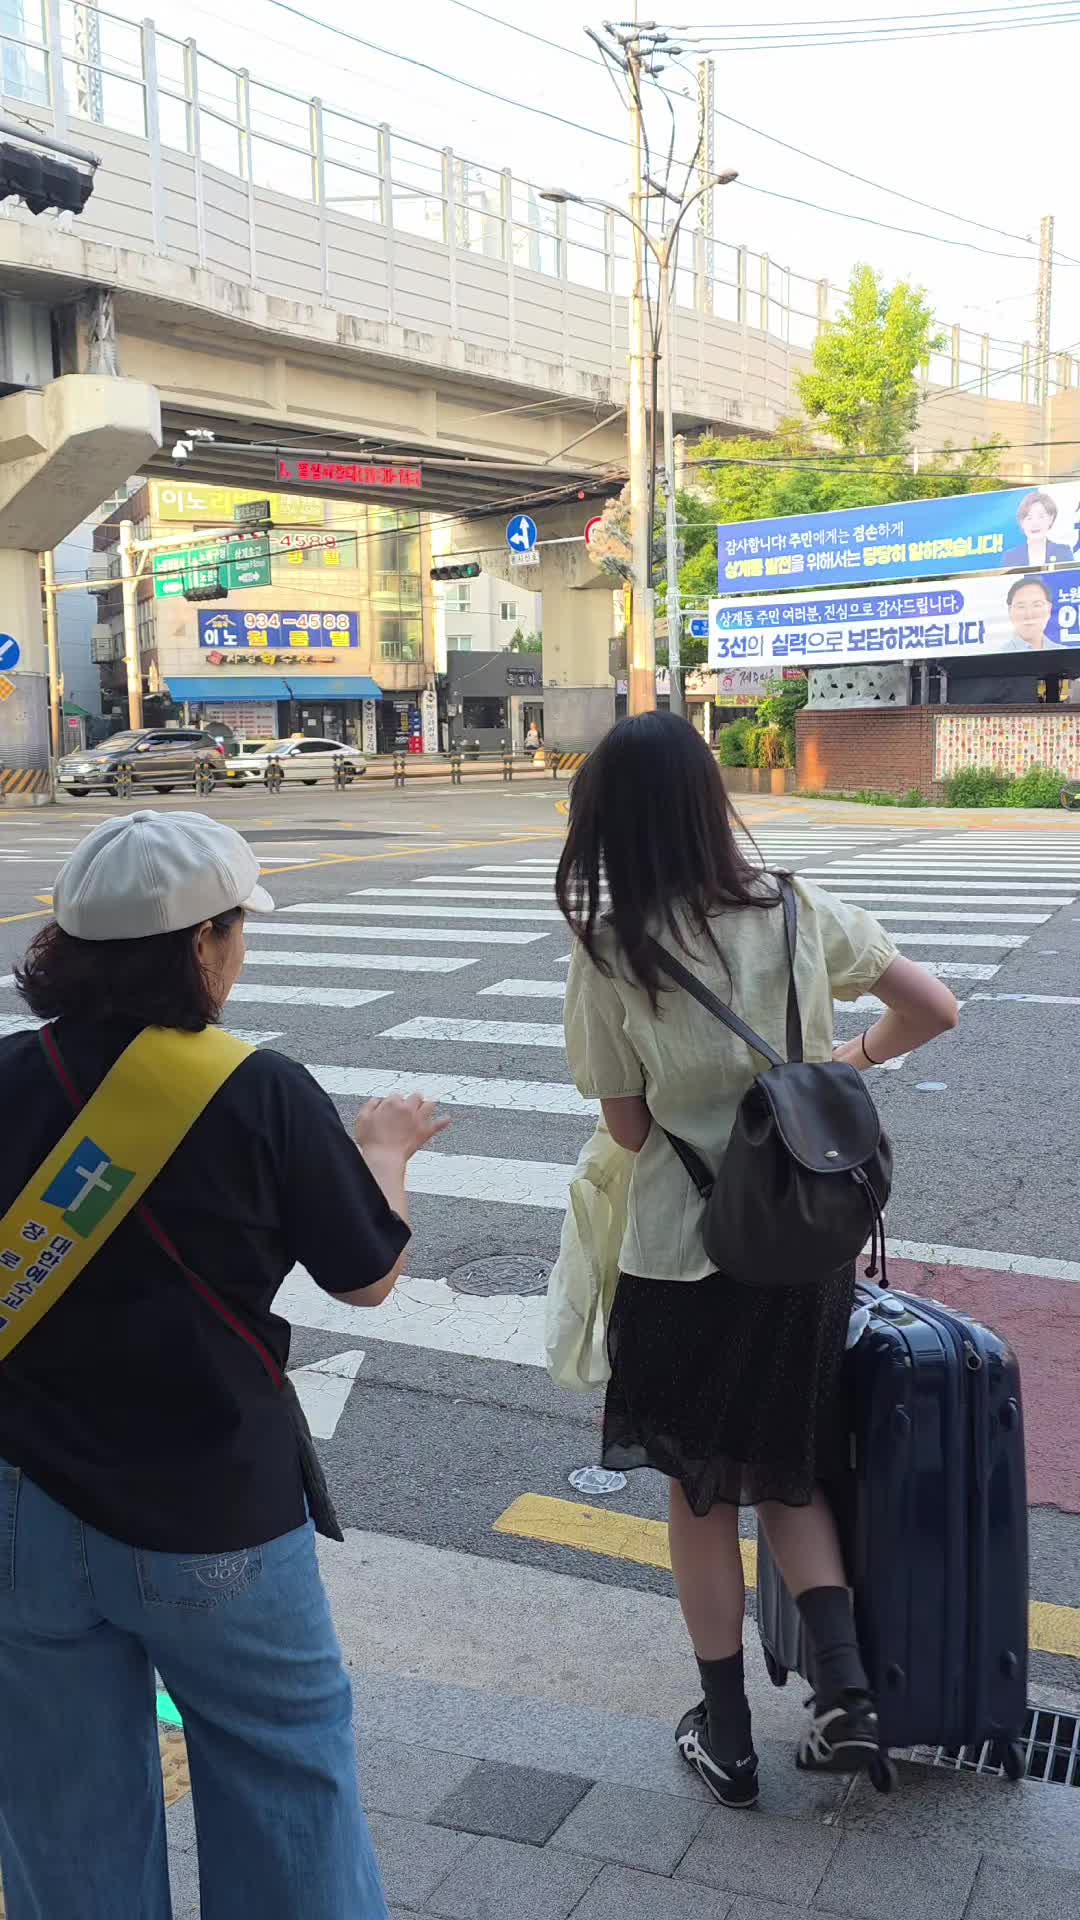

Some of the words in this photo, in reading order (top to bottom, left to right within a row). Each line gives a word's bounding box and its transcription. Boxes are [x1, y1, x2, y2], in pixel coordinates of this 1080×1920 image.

[725, 535, 787, 556] 감사합니다!
[788, 528, 850, 548] 주민에게는
[852, 521, 904, 543] 겸손하게
[725, 558, 763, 579] 상계동
[765, 554, 805, 576] 발전을
[806, 549, 861, 572] 위해서는
[863, 543, 906, 567] 당당히
[908, 533, 1004, 562] 일하겠습니다!
[243, 612, 350, 630] 934-4588
[719, 611, 754, 628] 상계동
[756, 607, 780, 625] 주민
[782, 605, 822, 624] 여러분,
[823, 602, 874, 621] 진심으로
[876, 594, 960, 617] 감사드립니다.
[204, 629, 238, 646] 이노
[717, 634, 764, 658] 3선의
[771, 631, 844, 657] 실력으로
[1, 1235, 73, 1311] 대한예수교
